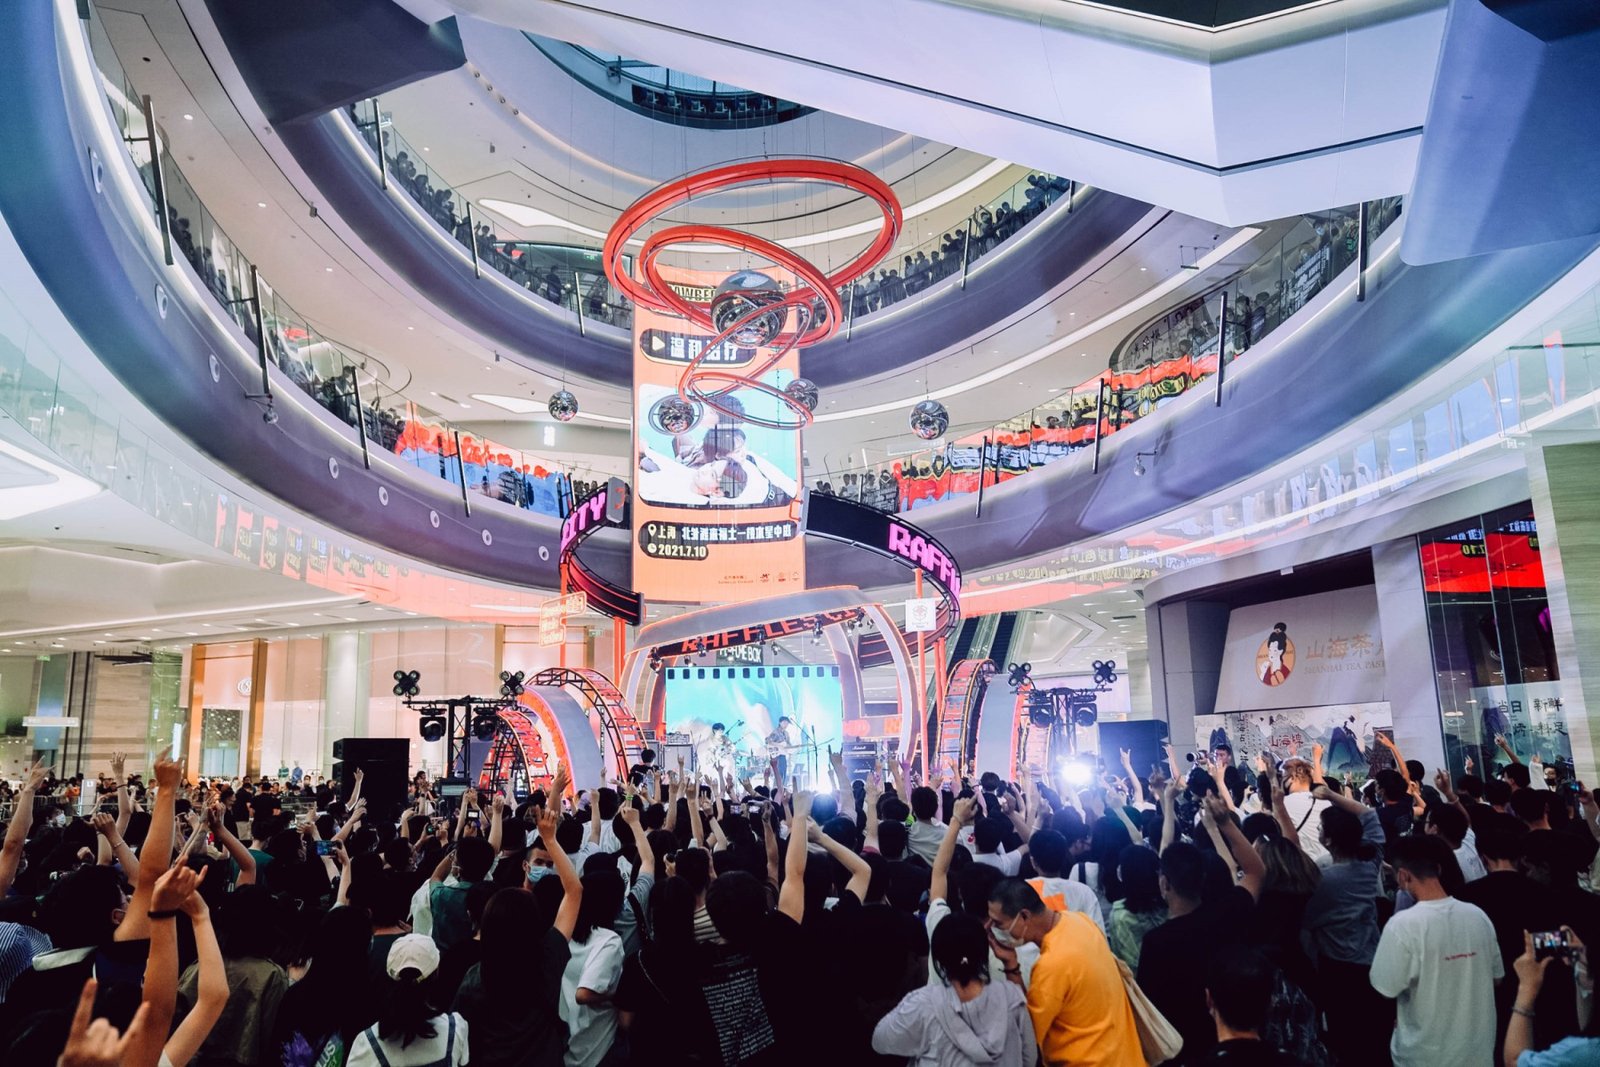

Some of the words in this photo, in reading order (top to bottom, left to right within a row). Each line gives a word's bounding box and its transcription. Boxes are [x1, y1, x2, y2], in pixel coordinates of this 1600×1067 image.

[657, 525, 676, 539] 上海
[658, 544, 707, 558] 2021.7.10
[747, 646, 762, 663] BOX
[1306, 634, 1383, 660] 山海茶
[1499, 700, 1522, 713] 当日
[1533, 697, 1563, 712] 新鲜
